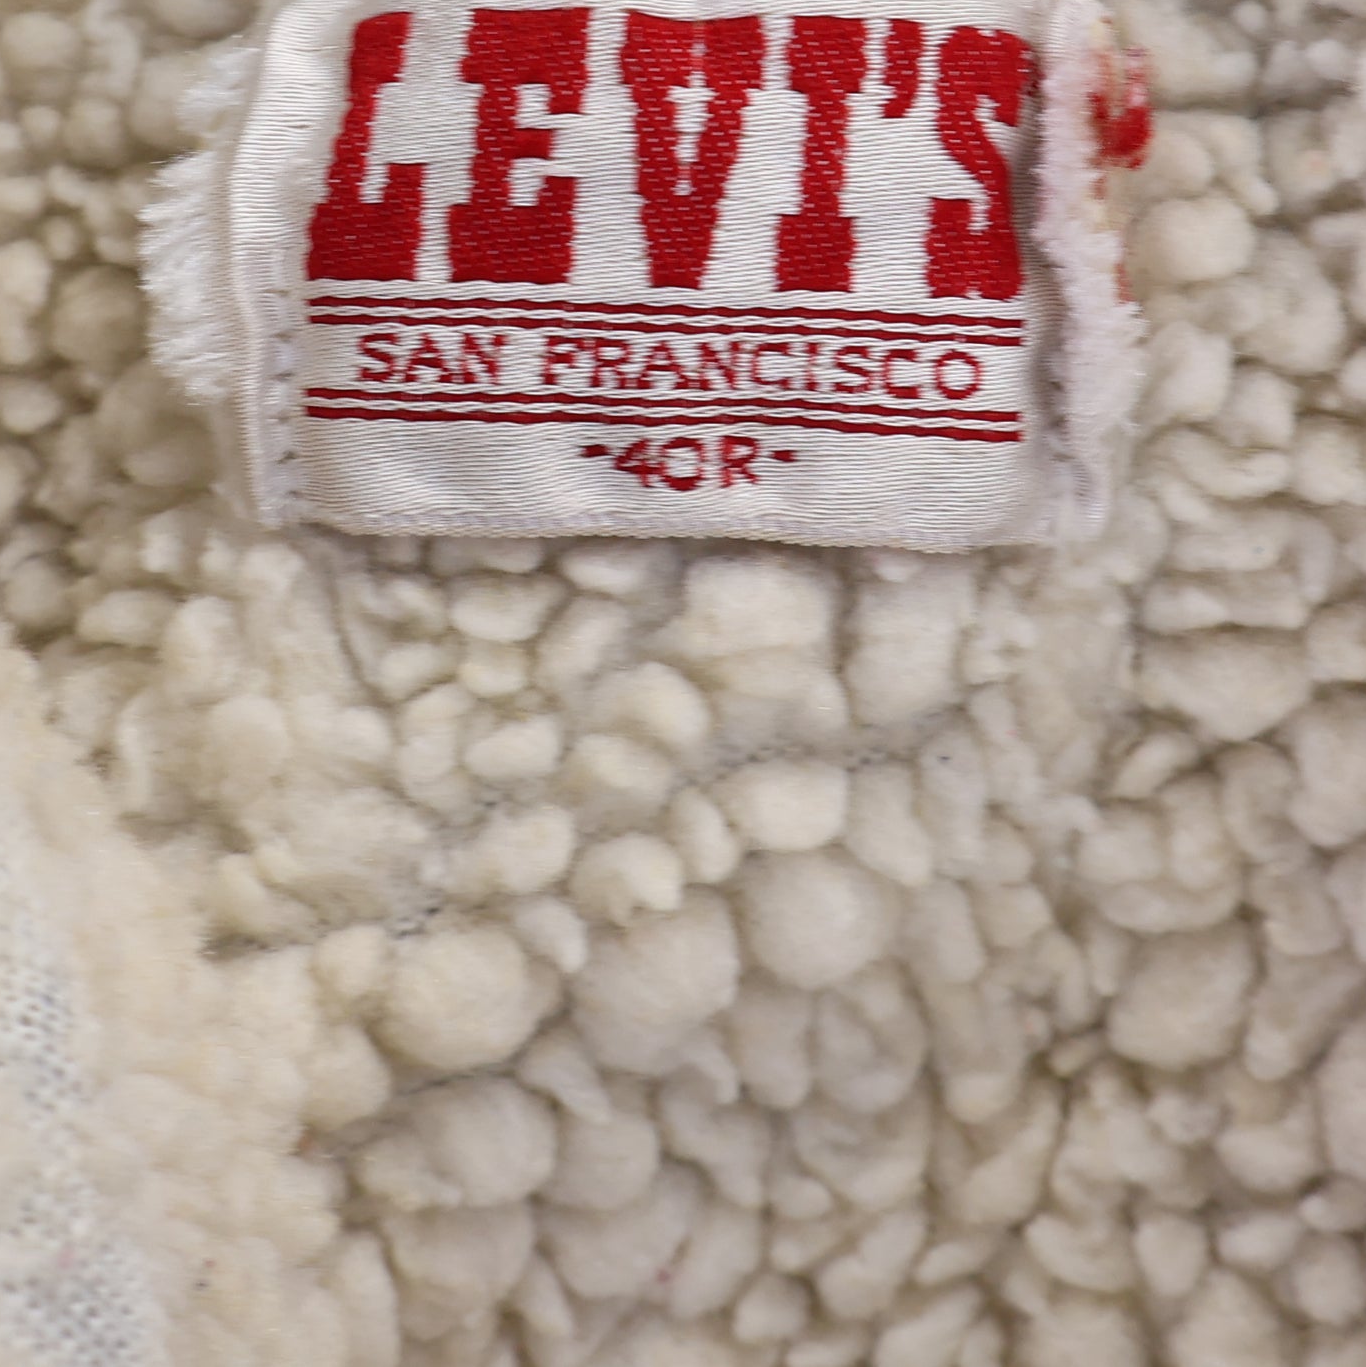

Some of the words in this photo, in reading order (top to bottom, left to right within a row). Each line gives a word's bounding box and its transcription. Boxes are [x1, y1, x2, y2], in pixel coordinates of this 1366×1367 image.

[304, 5, 1035, 301] LEVI'S
[357, 332, 508, 384] SAN
[541, 335, 985, 401] FRANCISCO
